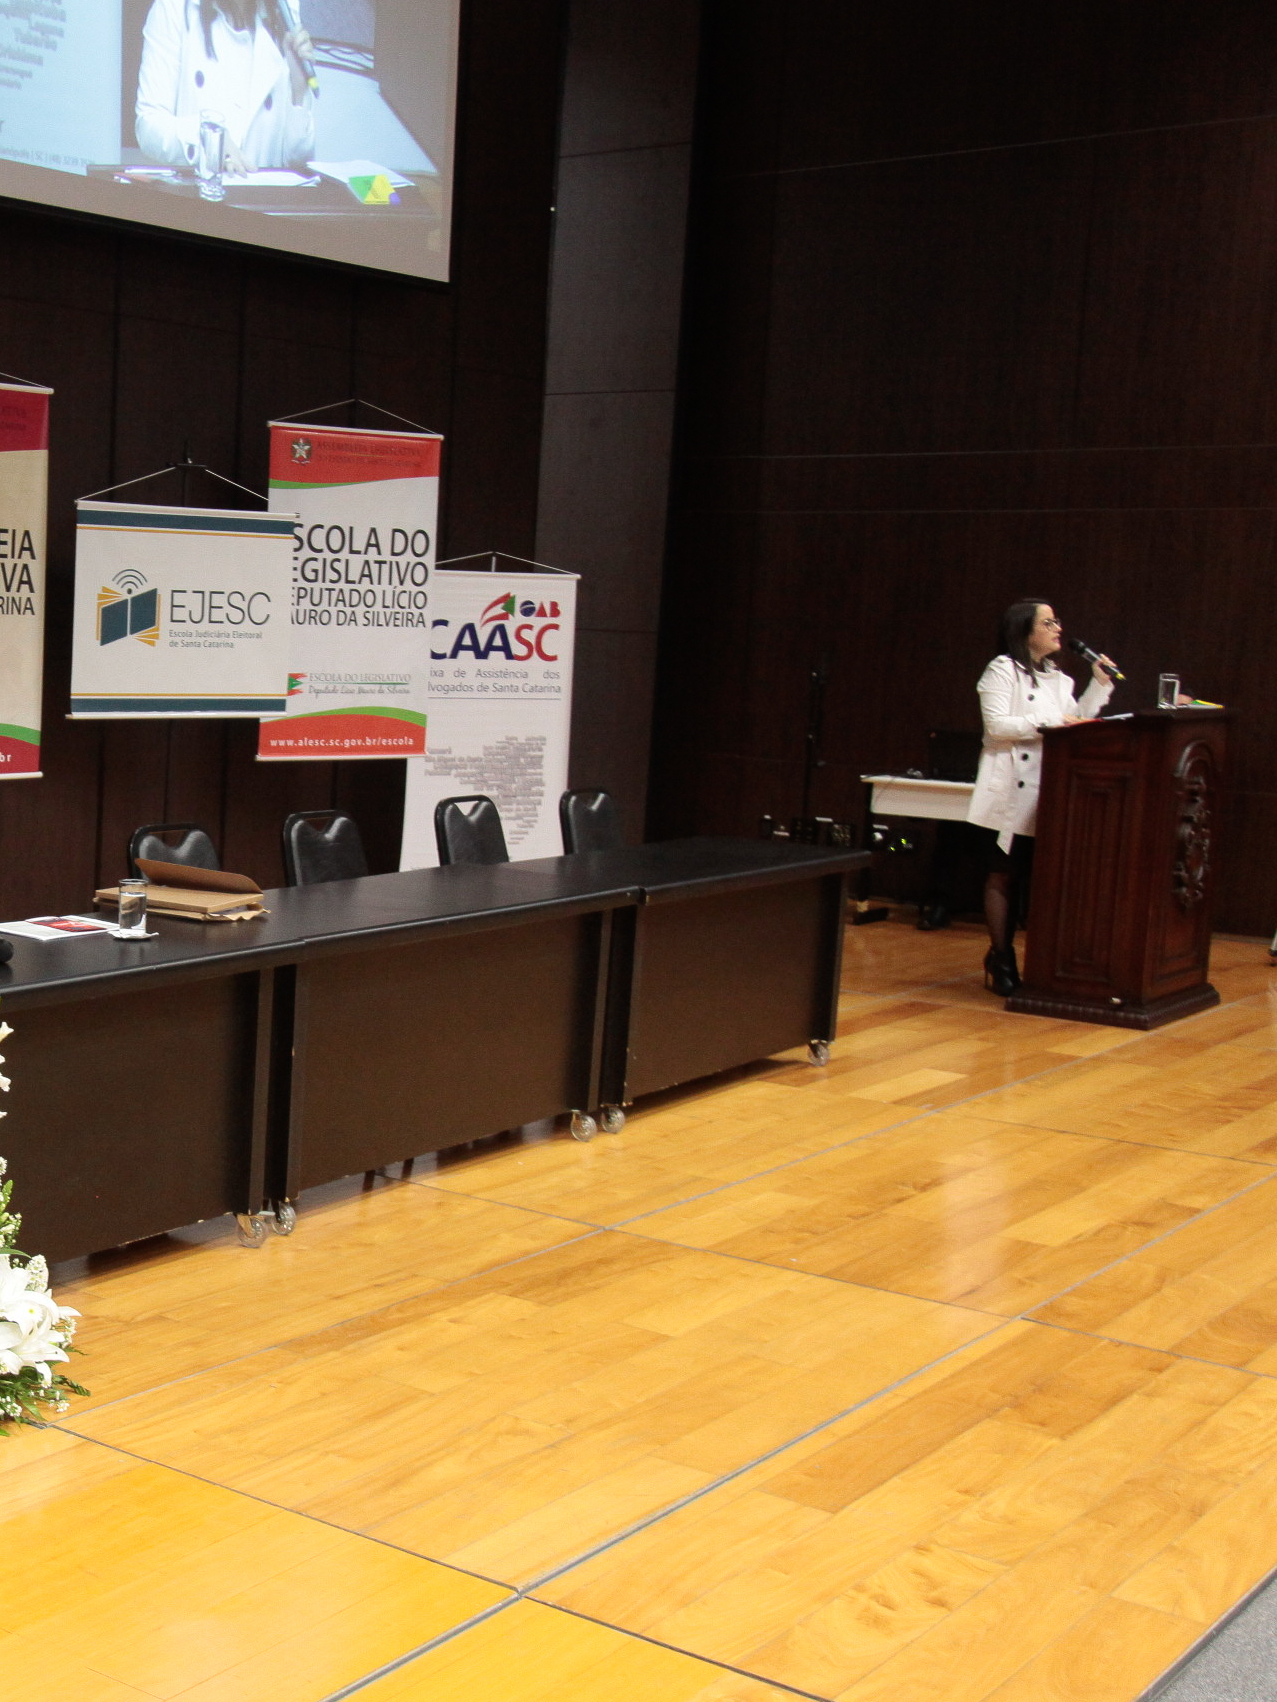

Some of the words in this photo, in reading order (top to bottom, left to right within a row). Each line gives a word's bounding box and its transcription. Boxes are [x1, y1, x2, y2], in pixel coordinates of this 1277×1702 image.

[293, 523, 382, 556] SCOLA
[390, 528, 430, 558] DO
[292, 556, 429, 587] GISLATIVO
[291, 587, 377, 609] PUTADO
[382, 586, 428, 610] LÍCIO
[169, 589, 271, 626] EJESC
[519, 600, 561, 618] OAB
[291, 609, 332, 626] URO
[336, 610, 359, 627] DA
[362, 610, 426, 628] SILVEIRA
[169, 629, 193, 638] Escola
[232, 630, 263, 639] Eleitoral
[169, 640, 178, 648] de
[180, 640, 202, 648] Santa
[203, 640, 235, 649] Catarina
[309, 673, 342, 682] ESCOLA
[343, 673, 359, 682] DO
[429, 668, 445, 678] ixa
[453, 668, 467, 678] de
[475, 668, 529, 679] Assistência
[542, 670, 561, 680] dos
[427, 681, 474, 695] vogados
[476, 682, 490, 692] de
[492, 683, 519, 693] Santa
[521, 683, 562, 694] Catarina
[269, 736, 414, 748] www.alesc.sc.gov.br/escola
